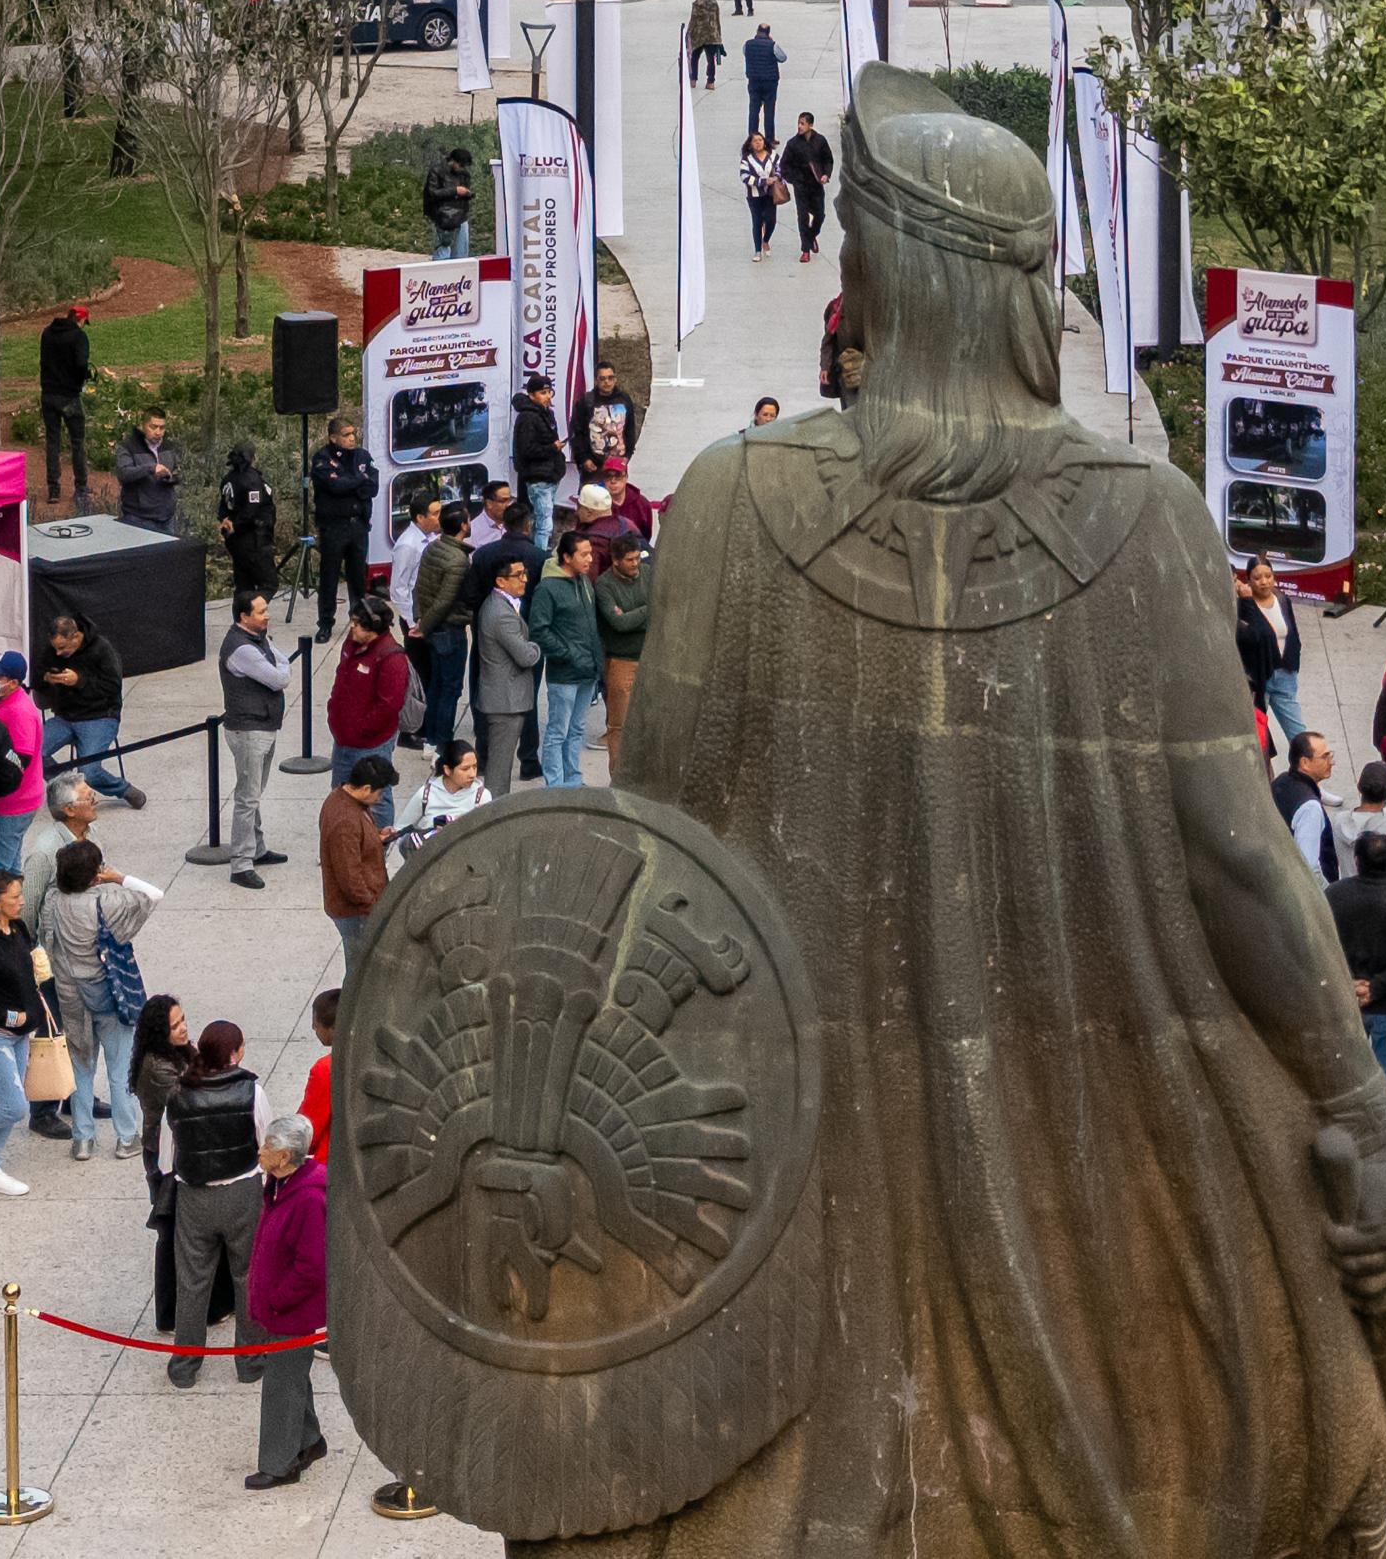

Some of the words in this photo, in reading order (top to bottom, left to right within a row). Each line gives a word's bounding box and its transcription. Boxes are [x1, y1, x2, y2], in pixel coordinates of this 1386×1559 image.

[545, 197, 557, 279] PROGRESO
[523, 198, 542, 324] CAPITAL
[408, 275, 472, 304] Alameda
[545, 281, 557, 291] Y
[407, 301, 473, 327] guapa
[1244, 291, 1308, 314] Alameda
[1243, 316, 1309, 338] guapa
[390, 344, 427, 356] PARQUE
[1226, 353, 1263, 365] PARQUE
